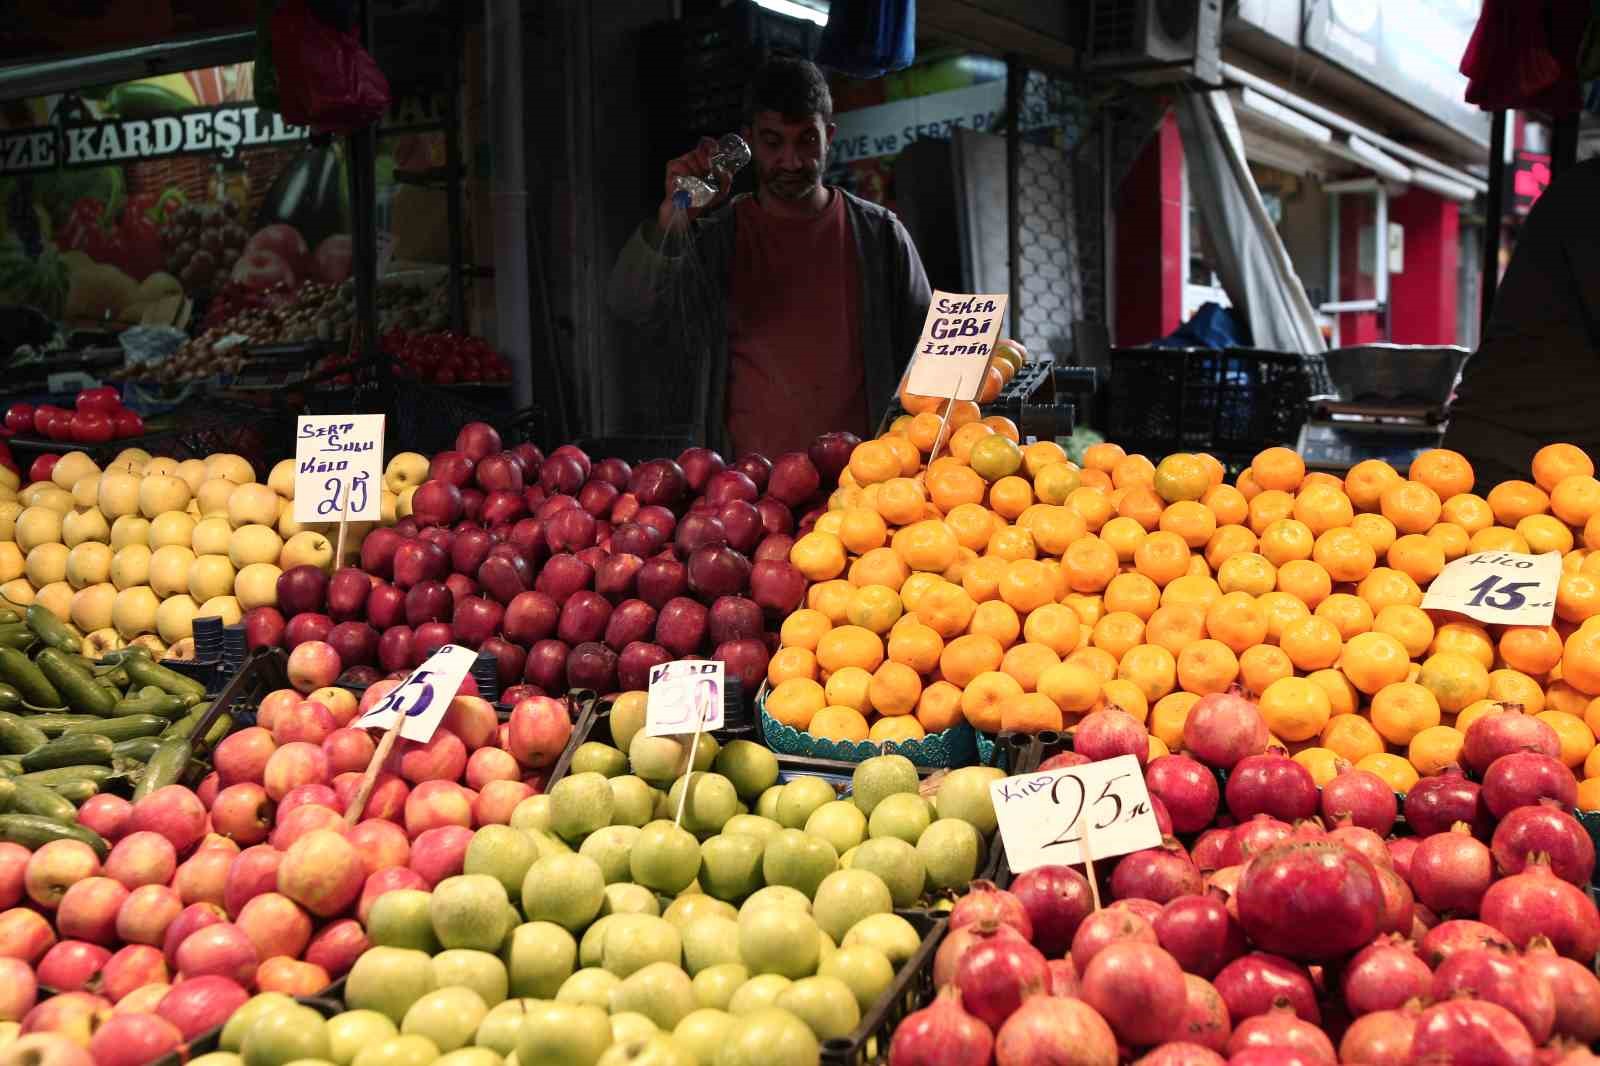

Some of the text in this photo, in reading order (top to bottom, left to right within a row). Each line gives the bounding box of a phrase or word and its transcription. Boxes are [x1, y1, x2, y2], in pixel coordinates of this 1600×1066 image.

[0, 106, 312, 170] ZE KARDEŞLE
[298, 423, 354, 439] SERT
[317, 470, 370, 515] 25
[1464, 574, 1542, 610] 15
[1040, 773, 1131, 849] 25
